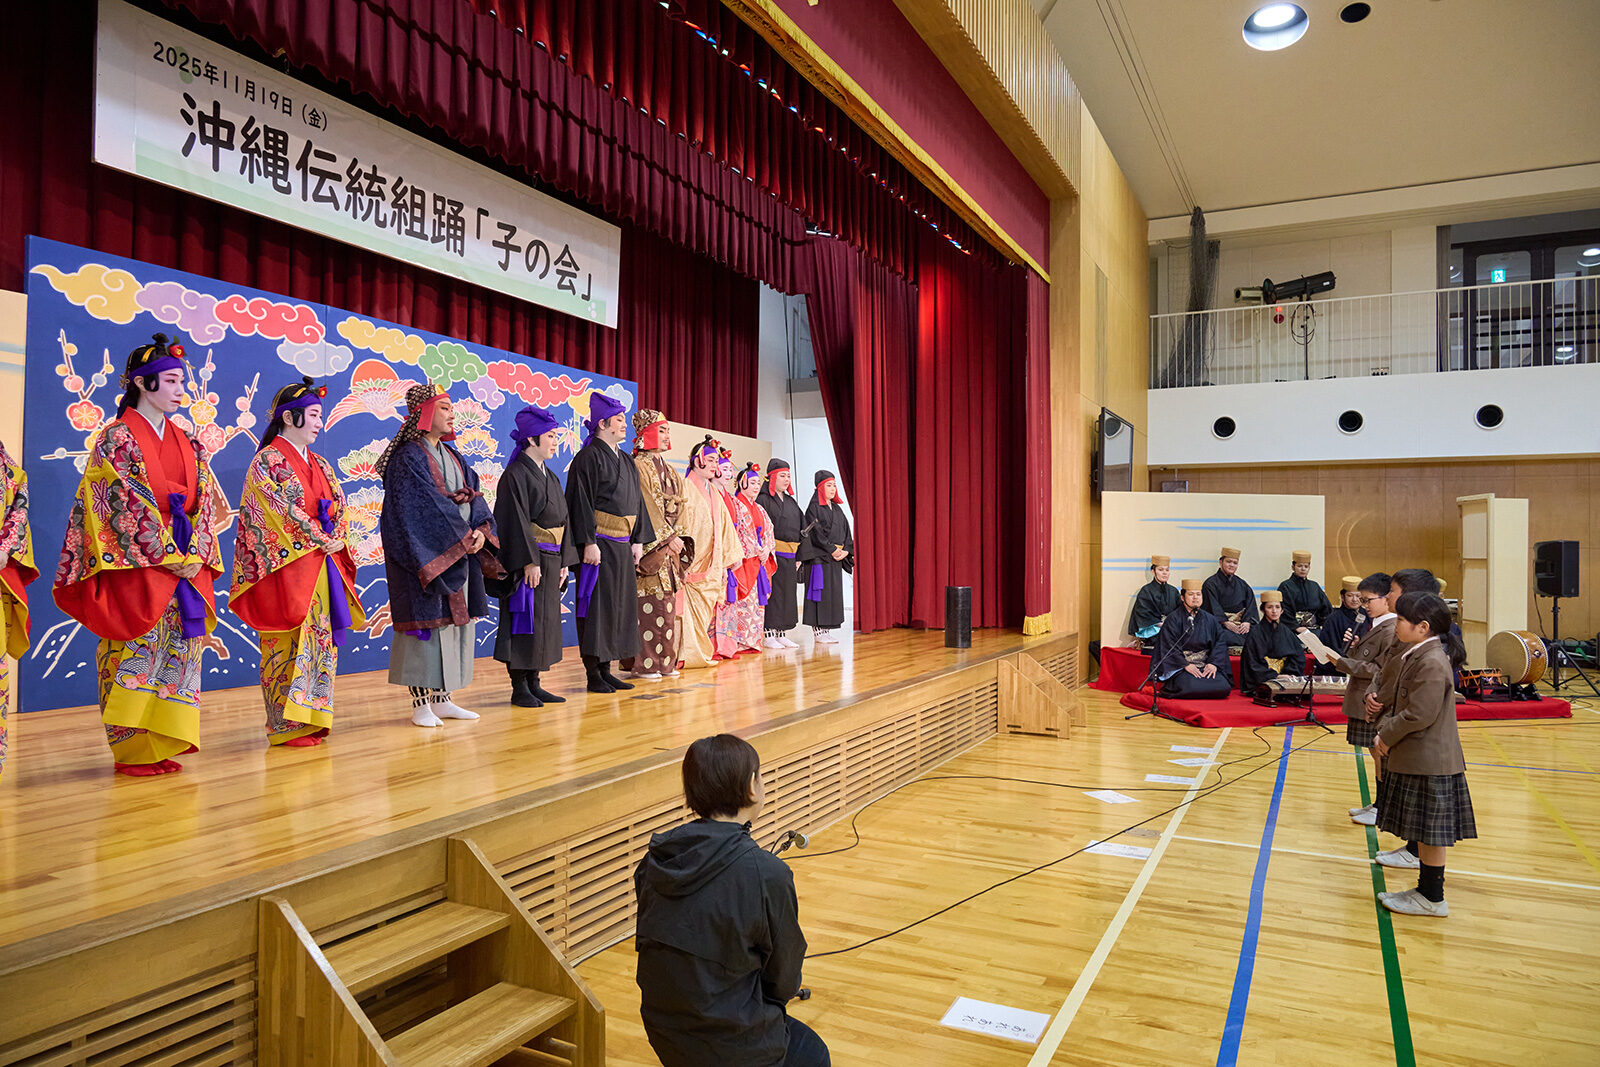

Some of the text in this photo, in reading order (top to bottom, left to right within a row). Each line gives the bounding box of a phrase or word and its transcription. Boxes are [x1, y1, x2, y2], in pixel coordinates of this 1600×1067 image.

[180, 92, 592, 302] 沖縄伝統組踊「子の会」
